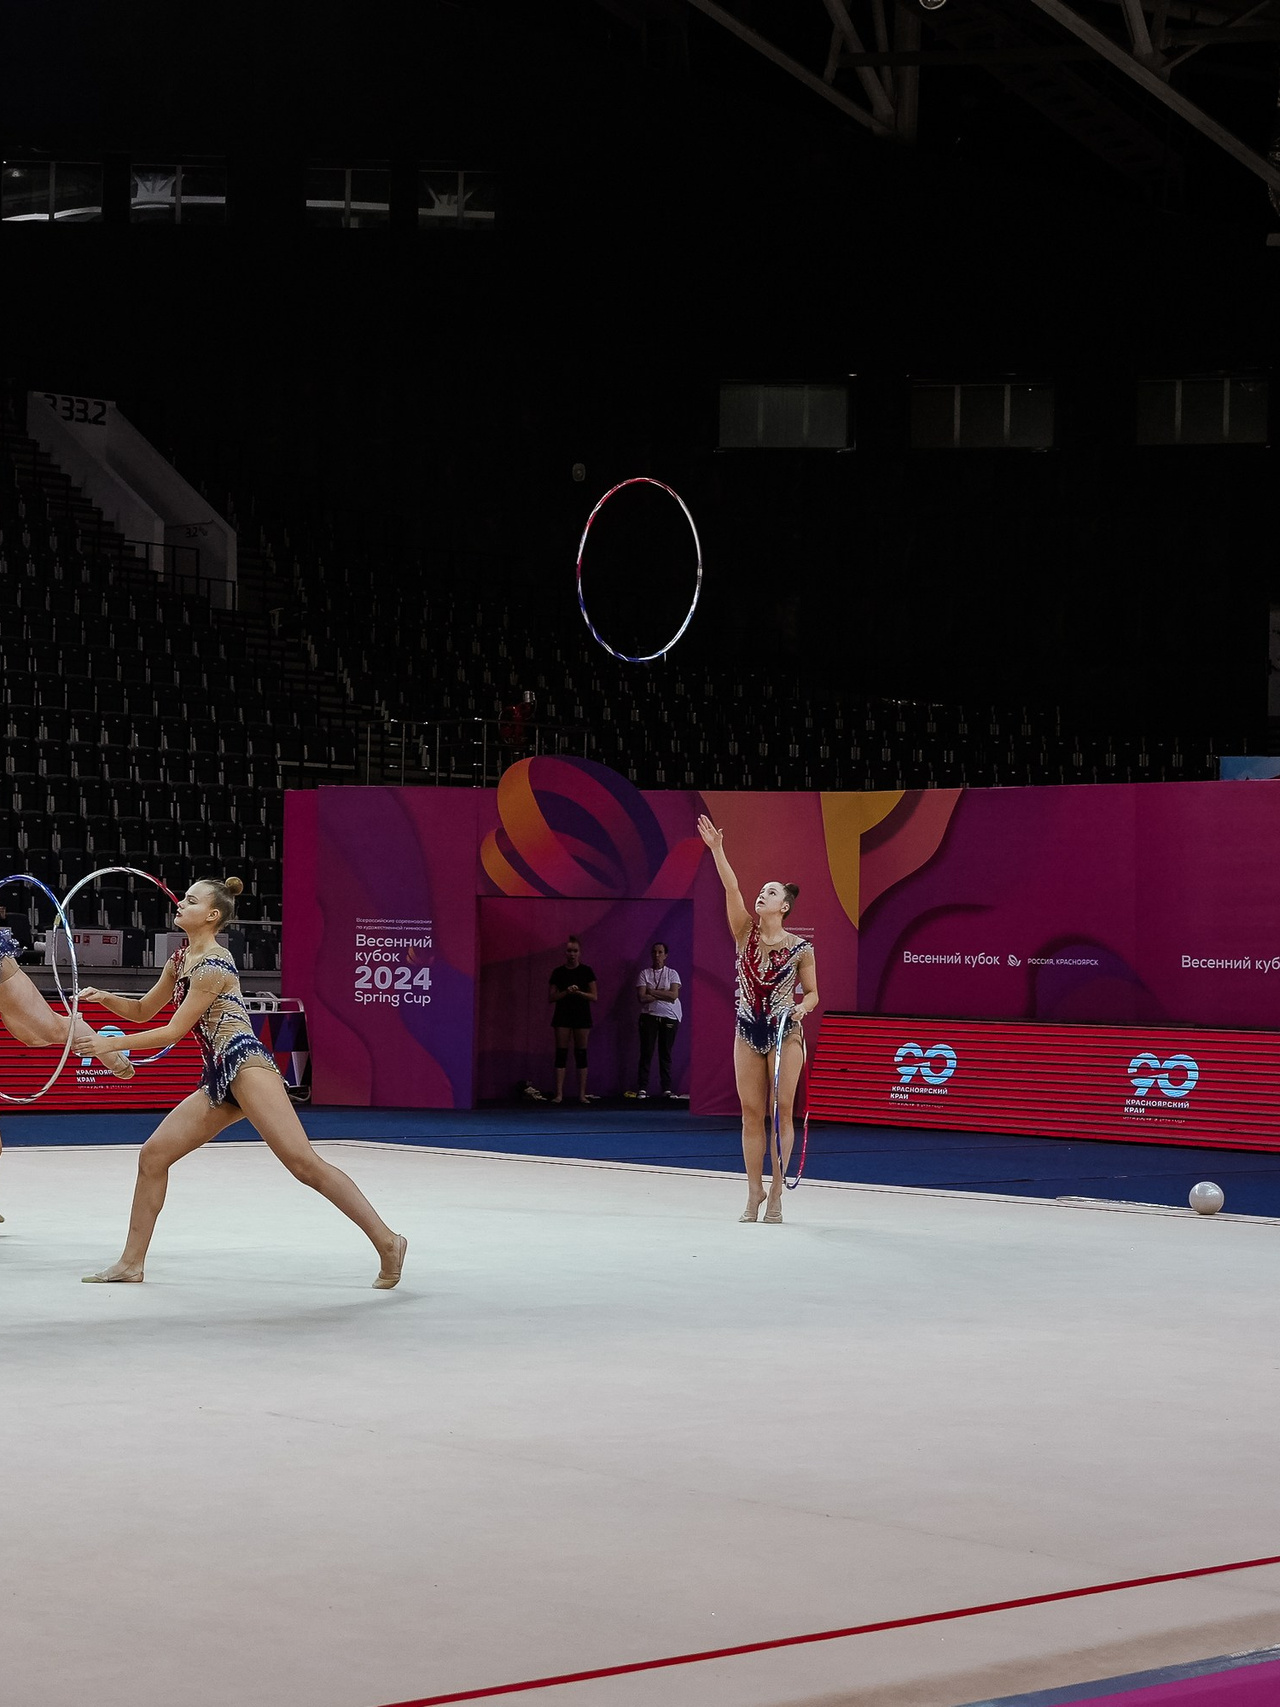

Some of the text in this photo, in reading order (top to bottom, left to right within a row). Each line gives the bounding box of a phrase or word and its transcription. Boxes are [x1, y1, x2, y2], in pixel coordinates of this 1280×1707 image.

[355, 934, 432, 948] Весенний
[355, 949, 400, 965] кубок
[903, 951, 1001, 968] Весенний кубок
[1056, 958, 1099, 966] КРАСНОЯРСК
[1181, 955, 1280, 974] Весенний куб
[354, 965, 432, 990] 2024
[354, 990, 431, 1007] Spring Cup
[894, 1042, 957, 1085] 90
[1127, 1052, 1199, 1098] 90
[891, 1086, 948, 1095] КРАСНОЯРСКИЙ
[1125, 1099, 1190, 1108] КРАСНОЯРСКИЙ
